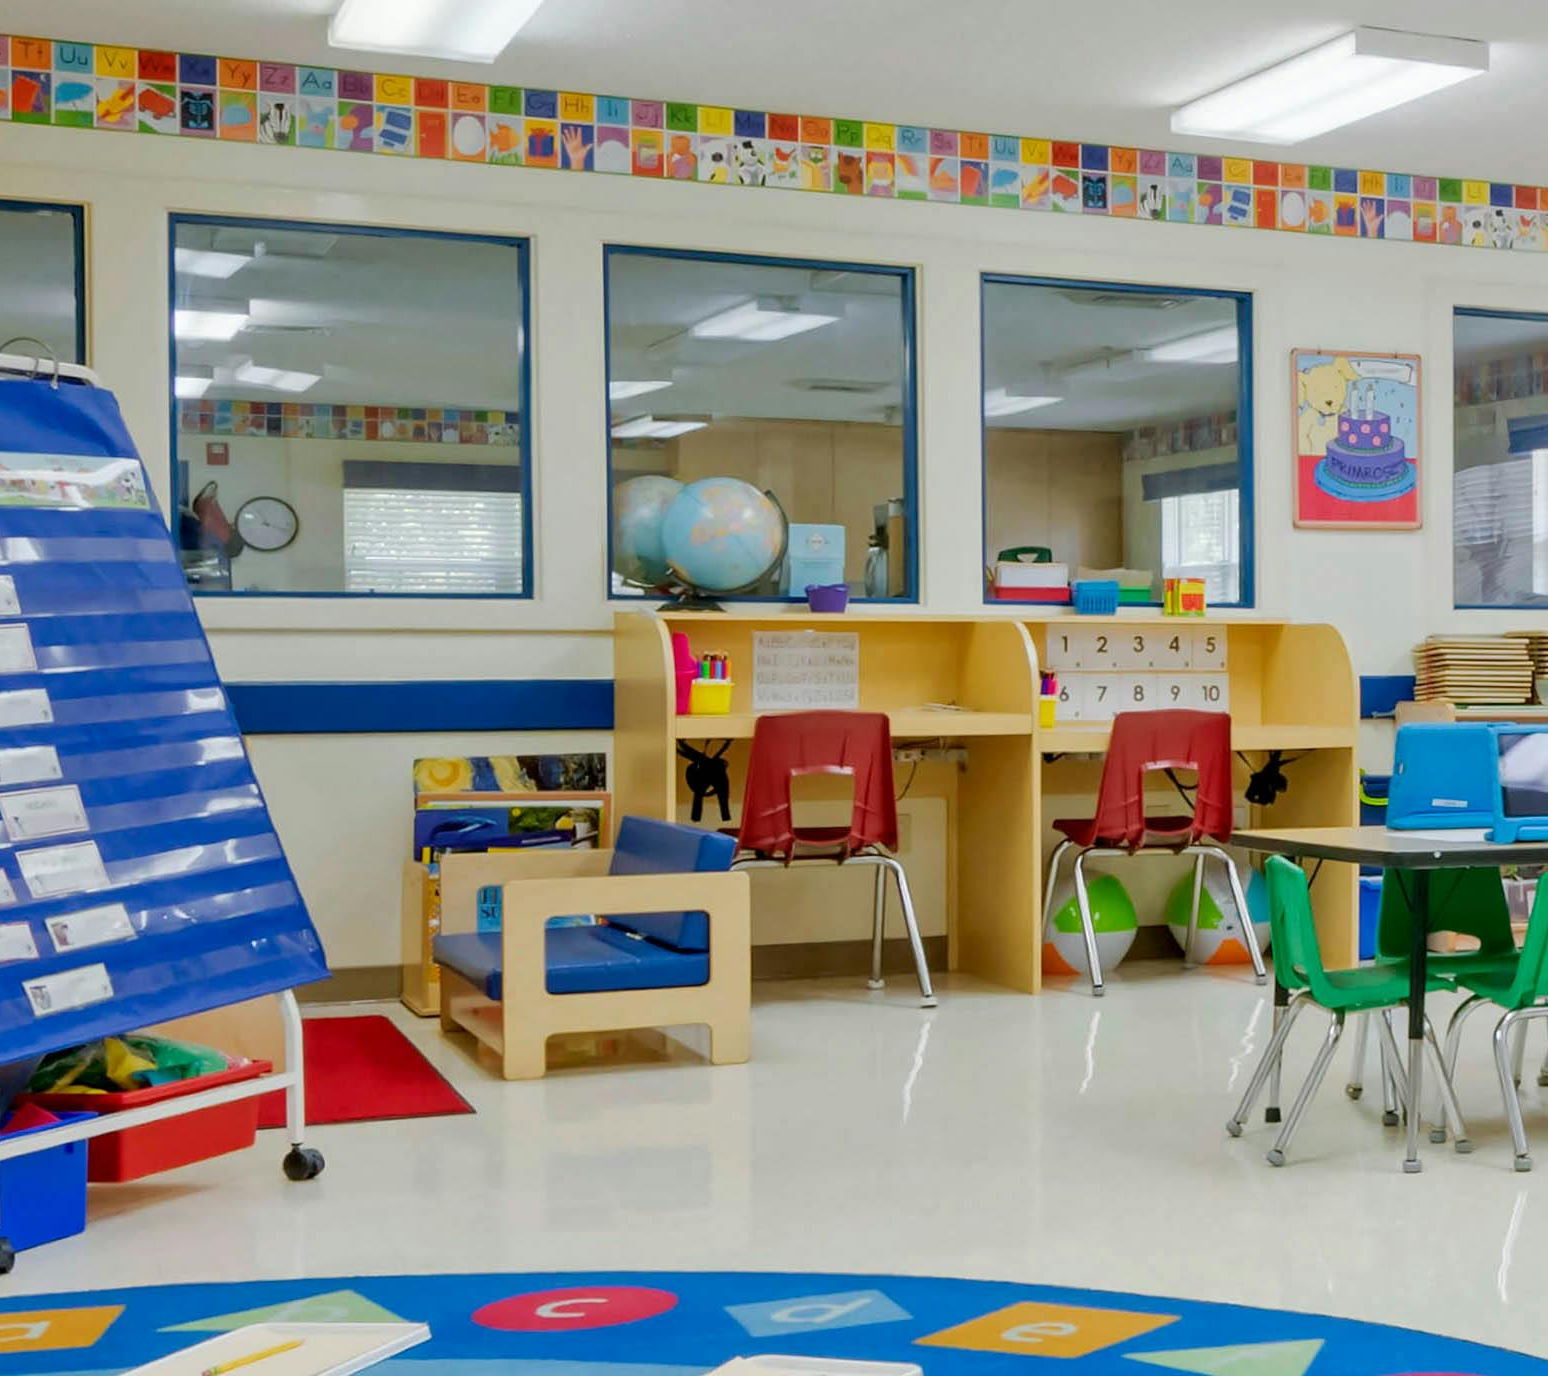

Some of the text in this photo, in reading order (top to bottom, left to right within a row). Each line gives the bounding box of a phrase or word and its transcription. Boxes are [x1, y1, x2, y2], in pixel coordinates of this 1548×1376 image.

[58, 44, 89, 66] Uu
[103, 50, 129, 71] Vv
[226, 65, 252, 87] Yy
[302, 69, 333, 92] Aa
[563, 95, 590, 115] Hh
[1061, 636, 1216, 653] 1 2 3 4 5
[1059, 685, 1220, 702] 6 7 8 9 10
[534, 1296, 609, 1319] c
[998, 1317, 1078, 1344] e
